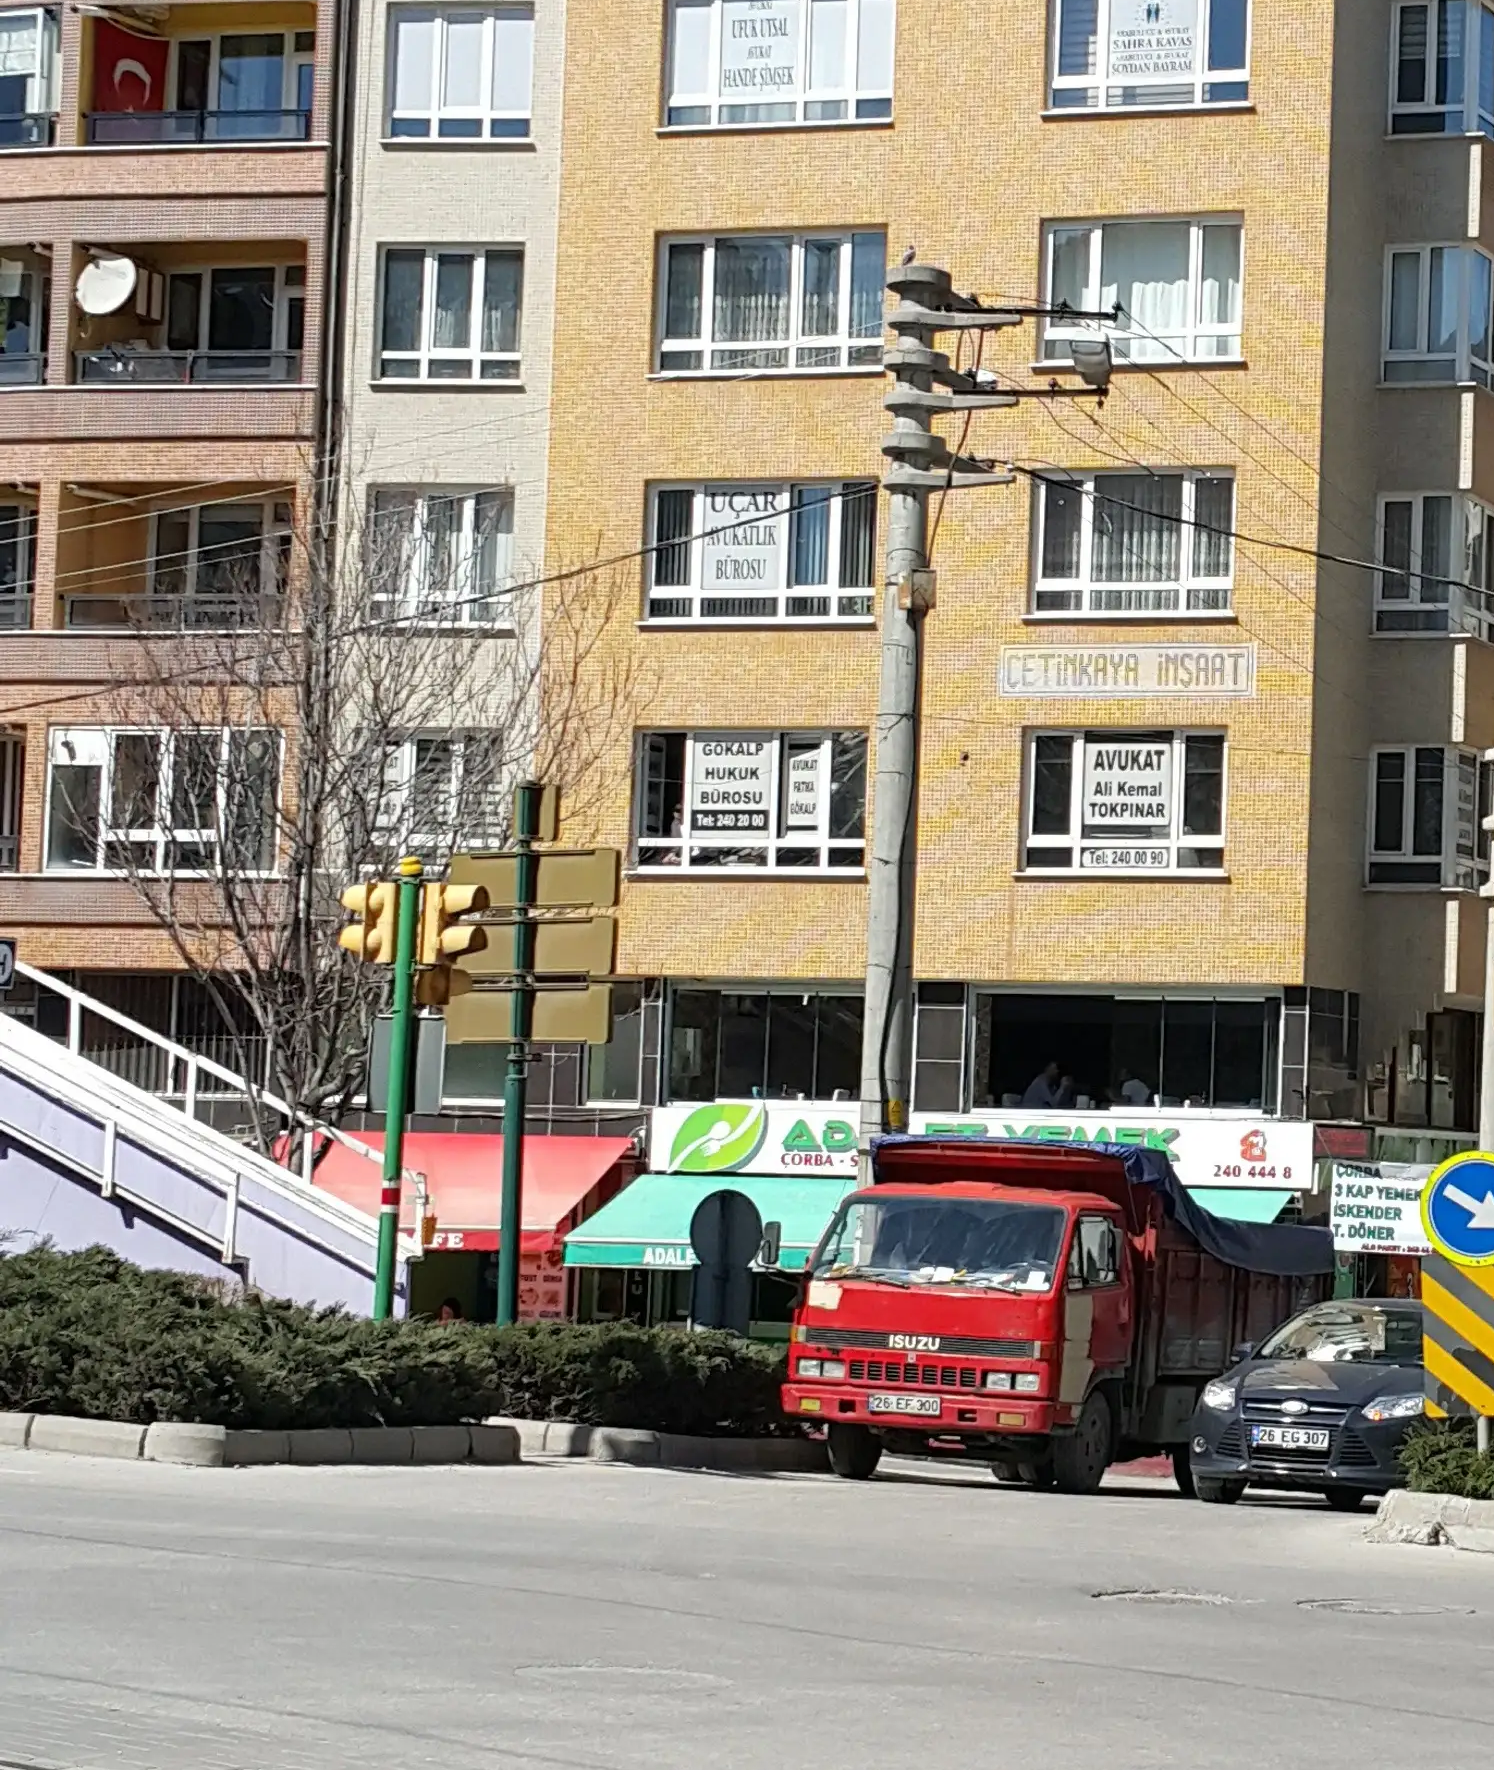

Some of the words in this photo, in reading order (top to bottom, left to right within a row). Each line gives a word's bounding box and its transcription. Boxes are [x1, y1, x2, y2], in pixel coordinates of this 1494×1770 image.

[709, 491, 779, 519] UÇAR
[706, 524, 777, 547] AVUKATLIK
[715, 555, 768, 580] BÜROSU
[1093, 749, 1165, 771] AVUKAT
[705, 767, 760, 780] HUKUK
[700, 789, 763, 805] BÜROSU
[1093, 780, 1113, 797] Ali
[1117, 780, 1163, 797] Kemal
[1089, 802, 1166, 818] TOKPINAR
[737, 813, 750, 827] 20
[751, 814, 765, 827] 00
[1089, 850, 1108, 865] Tel:
[1111, 850, 1131, 865] 240
[1134, 850, 1148, 865] 00
[1150, 850, 1164, 865] 90
[1213, 1165, 1242, 1178] 240
[1248, 1165, 1277, 1179] 444
[1282, 1166, 1292, 1179] 8
[1334, 1183, 1344, 1198] 3
[1346, 1184, 1374, 1199] KAP
[1347, 1220, 1396, 1241] DÖNER
[643, 1245, 699, 1266] ADALE
[888, 1334, 941, 1351] ISUZU
[874, 1396, 890, 1410] 26
[896, 1397, 915, 1411] EF
[916, 1399, 939, 1413] 300
[1259, 1429, 1276, 1442] 26
[1281, 1430, 1301, 1443] EG
[1303, 1431, 1327, 1446] 307
